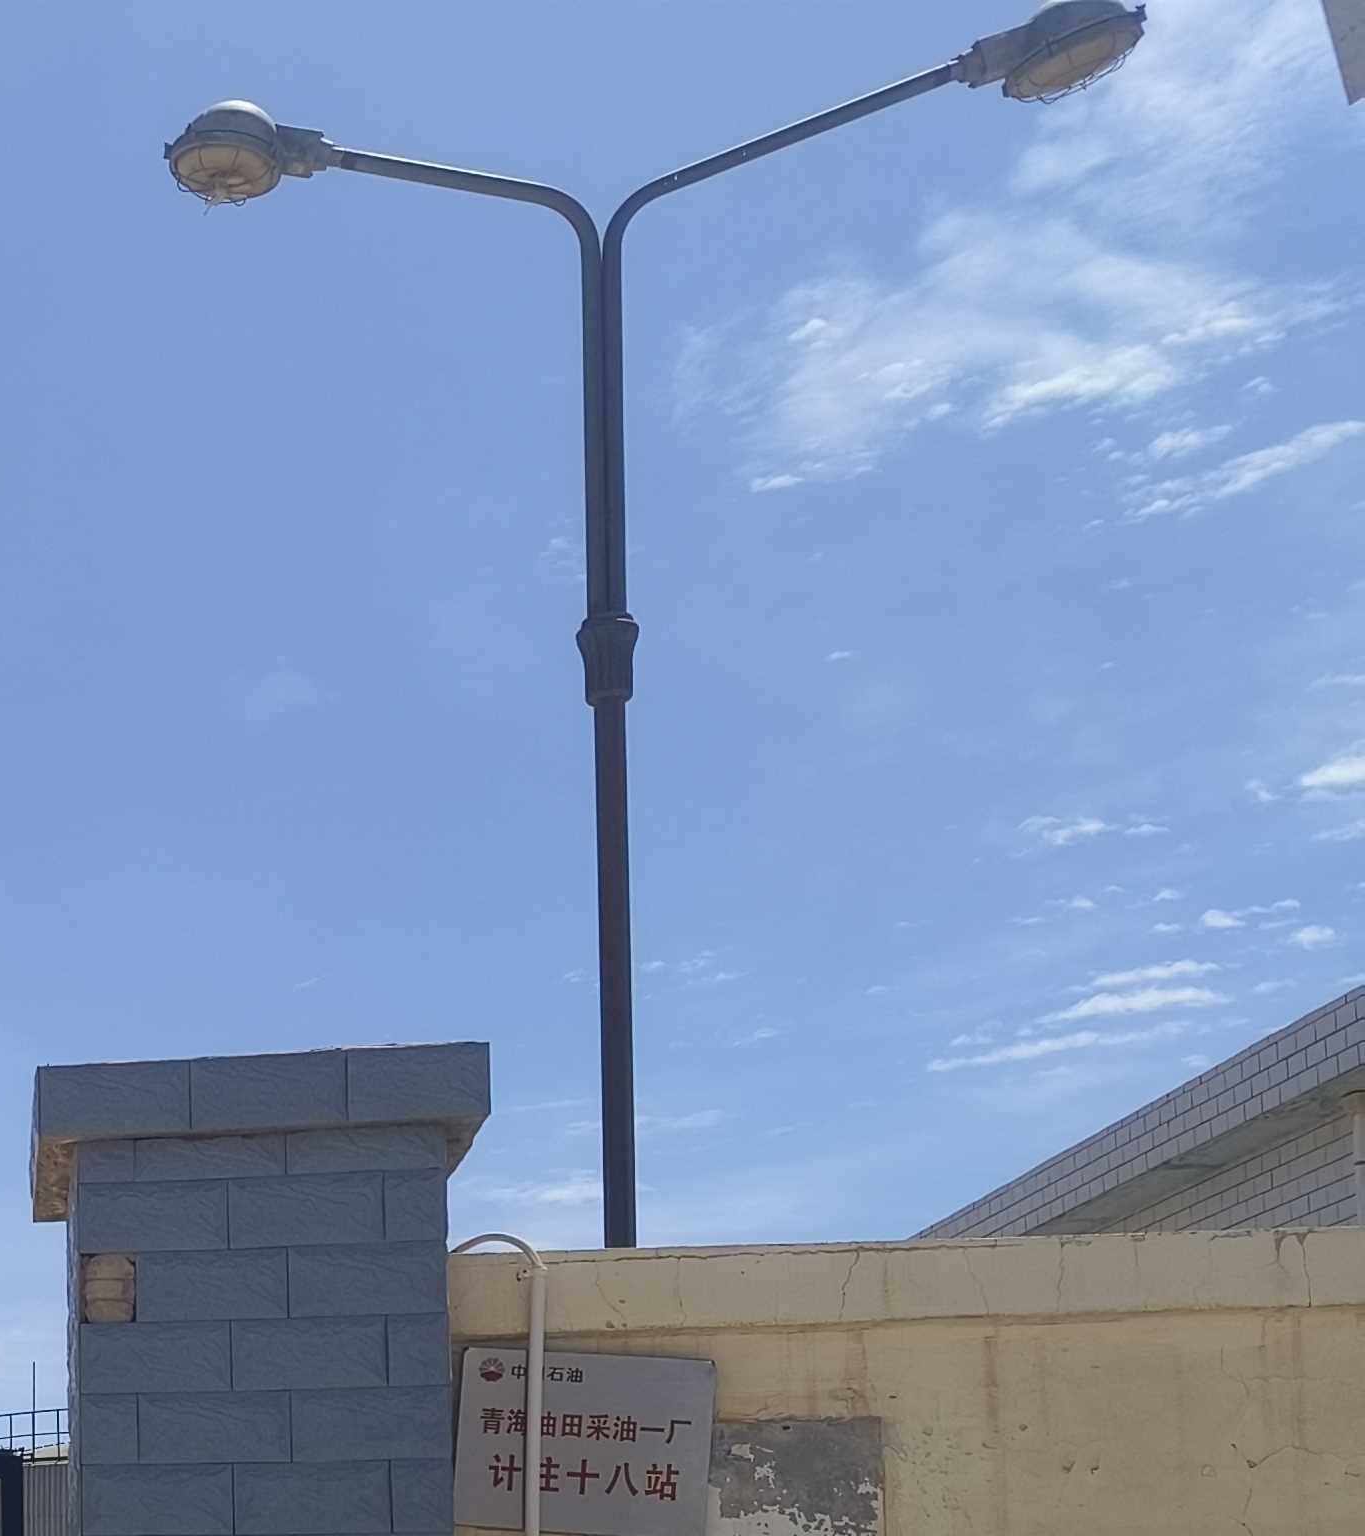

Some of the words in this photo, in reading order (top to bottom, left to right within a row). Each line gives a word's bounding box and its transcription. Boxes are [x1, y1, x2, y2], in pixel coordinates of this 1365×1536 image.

[510, 1364, 584, 1383] 中石油
[480, 1407, 692, 1444] 青海油田采油一厂
